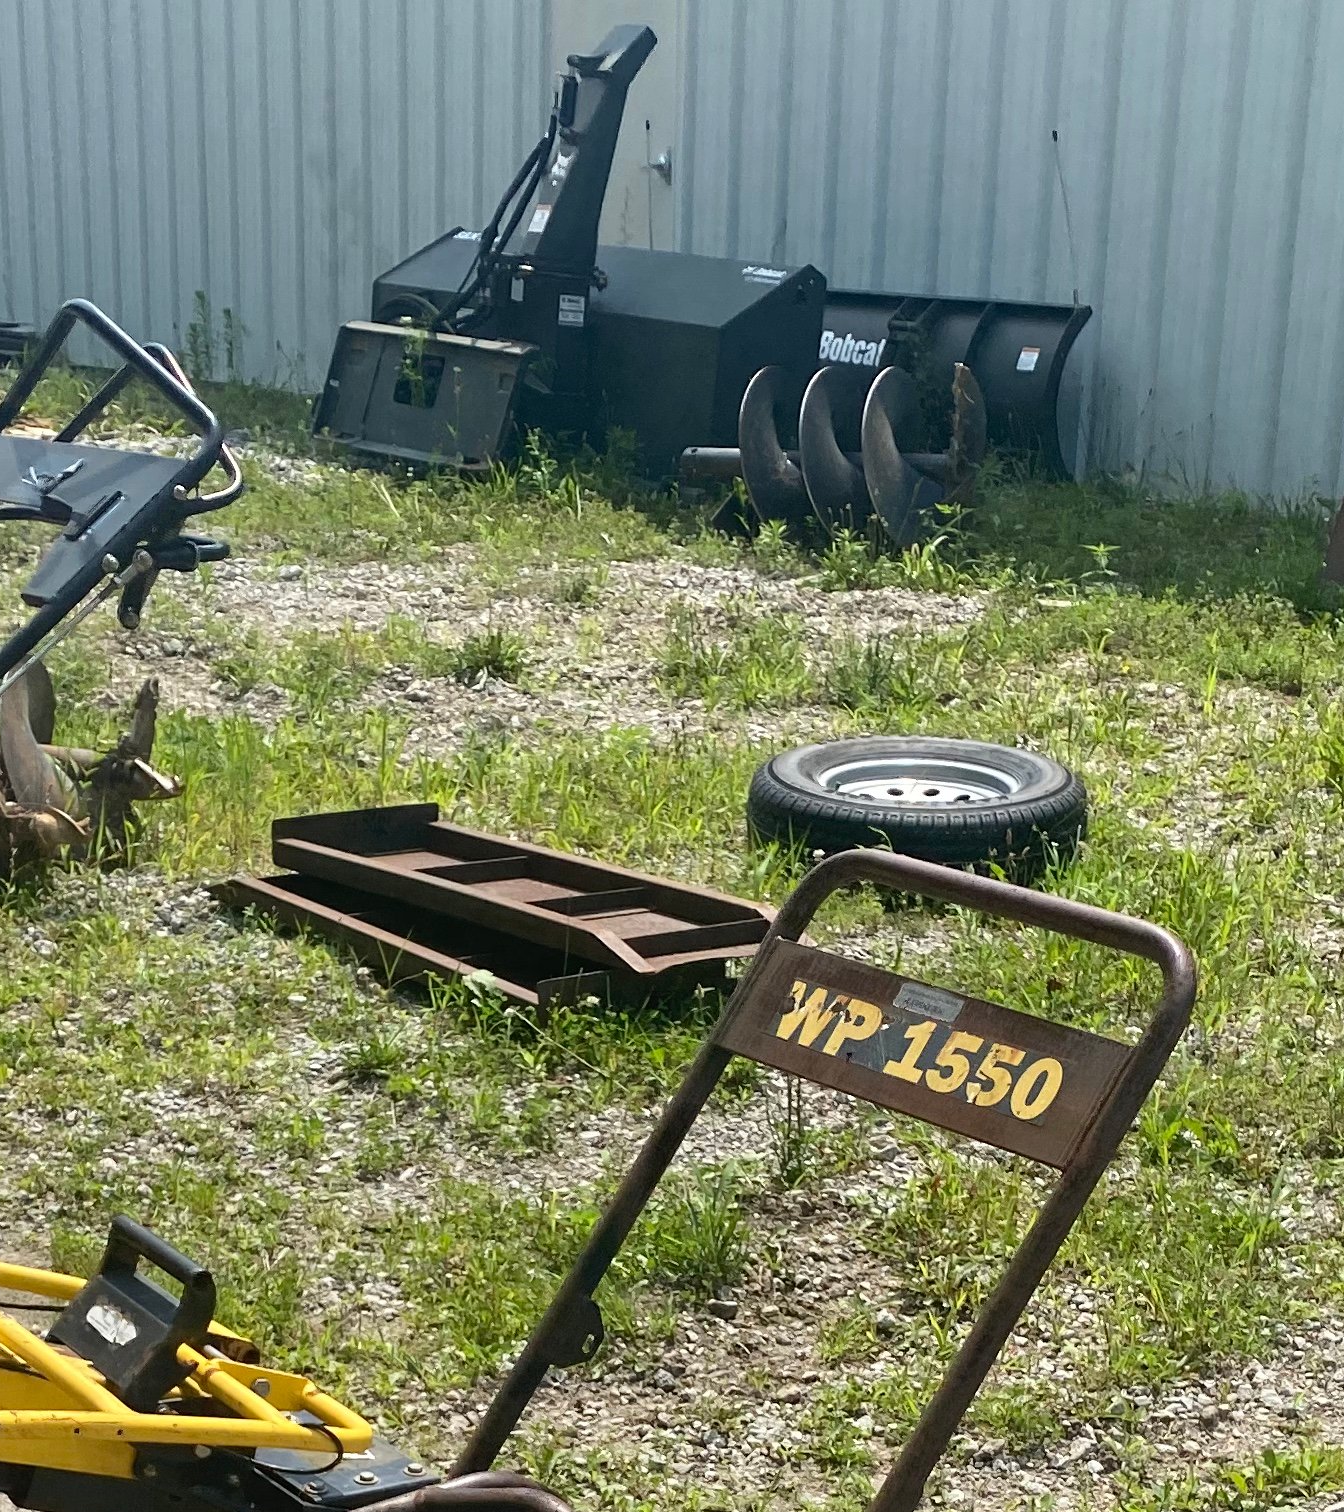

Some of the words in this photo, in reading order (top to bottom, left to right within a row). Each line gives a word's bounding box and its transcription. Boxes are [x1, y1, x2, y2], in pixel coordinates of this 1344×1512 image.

[819, 330, 886, 367] Bobcat
[775, 980, 883, 1056] WP
[882, 1020, 1063, 1120] 1550
